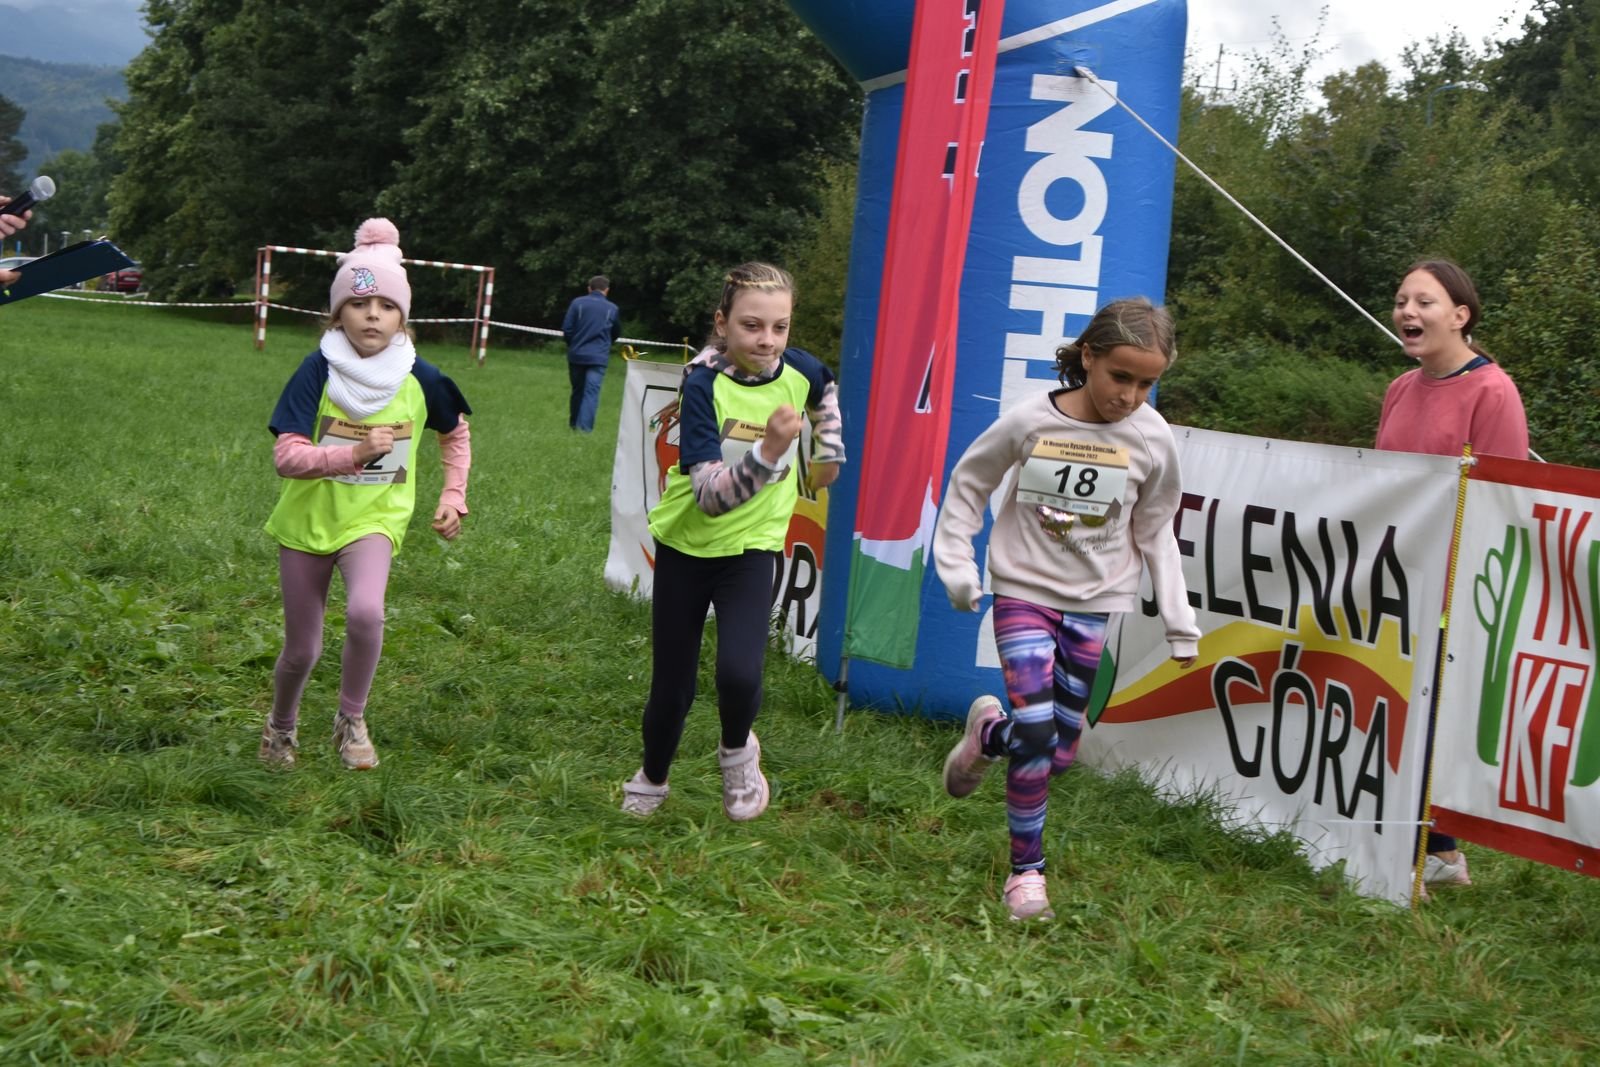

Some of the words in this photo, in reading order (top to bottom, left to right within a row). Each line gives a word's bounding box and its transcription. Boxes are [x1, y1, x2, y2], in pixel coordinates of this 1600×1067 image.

[1054, 464, 1099, 497] 18
[1142, 492, 1412, 657] ELENIA
[1213, 643, 1387, 835] GÓRA
